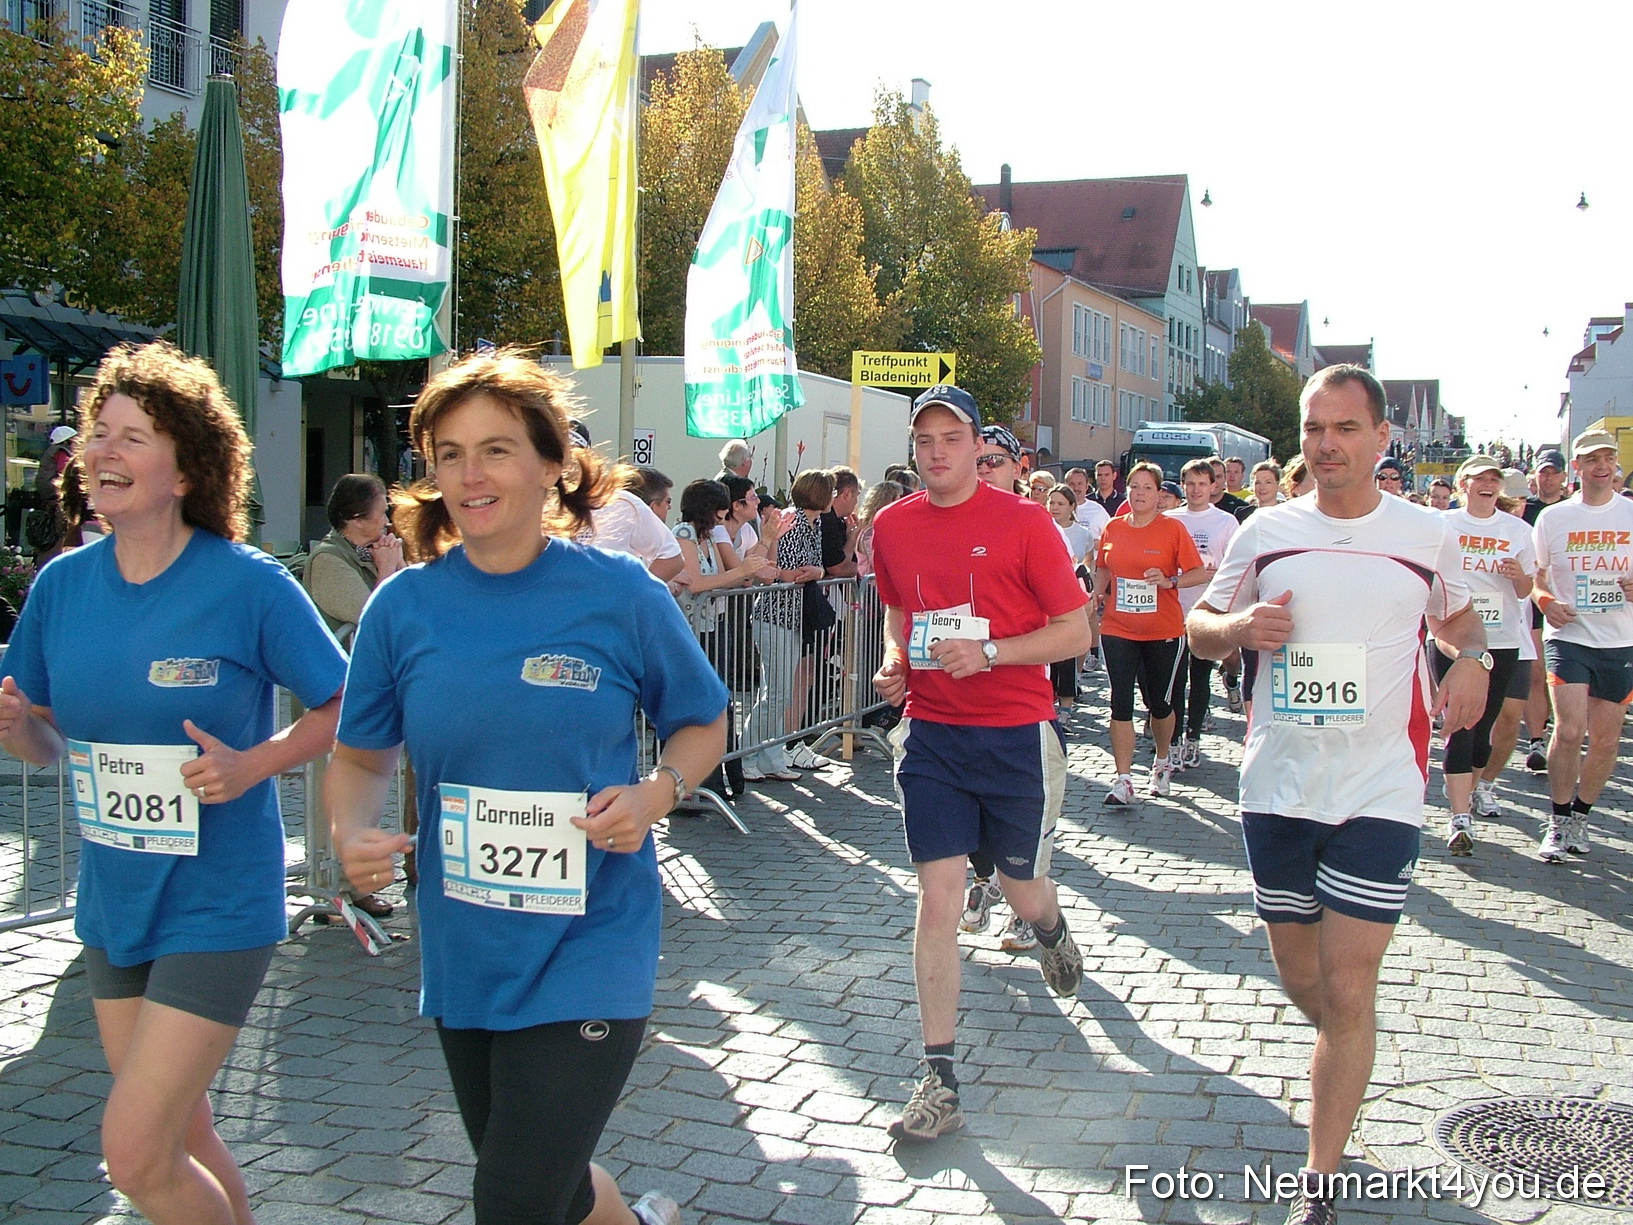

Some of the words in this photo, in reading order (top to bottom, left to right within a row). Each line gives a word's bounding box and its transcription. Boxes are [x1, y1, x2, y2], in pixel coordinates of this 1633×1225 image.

[861, 354, 928, 369] Treffpunkt
[860, 370, 931, 385] Bladenight
[1567, 530, 1631, 544] MERZ
[1565, 542, 1616, 553] Reisen
[1567, 556, 1629, 571] TEAM
[1590, 578, 1614, 586] Michael
[1127, 594, 1154, 604] 2108
[1591, 592, 1622, 603] 2686
[931, 612, 961, 630] Georg
[913, 631, 918, 641] C
[1291, 651, 1313, 667] Udo
[1293, 681, 1357, 704] 2916
[1325, 714, 1364, 723] PFLEIDERER
[99, 752, 144, 775] Petra
[77, 779, 85, 793] C
[106, 790, 183, 823] 2081
[476, 799, 554, 827] Cornelia
[146, 836, 195, 848] PFLEIDERER
[445, 829, 453, 845] D
[479, 842, 568, 880] 3271
[525, 894, 582, 907] PFLEIDERER
